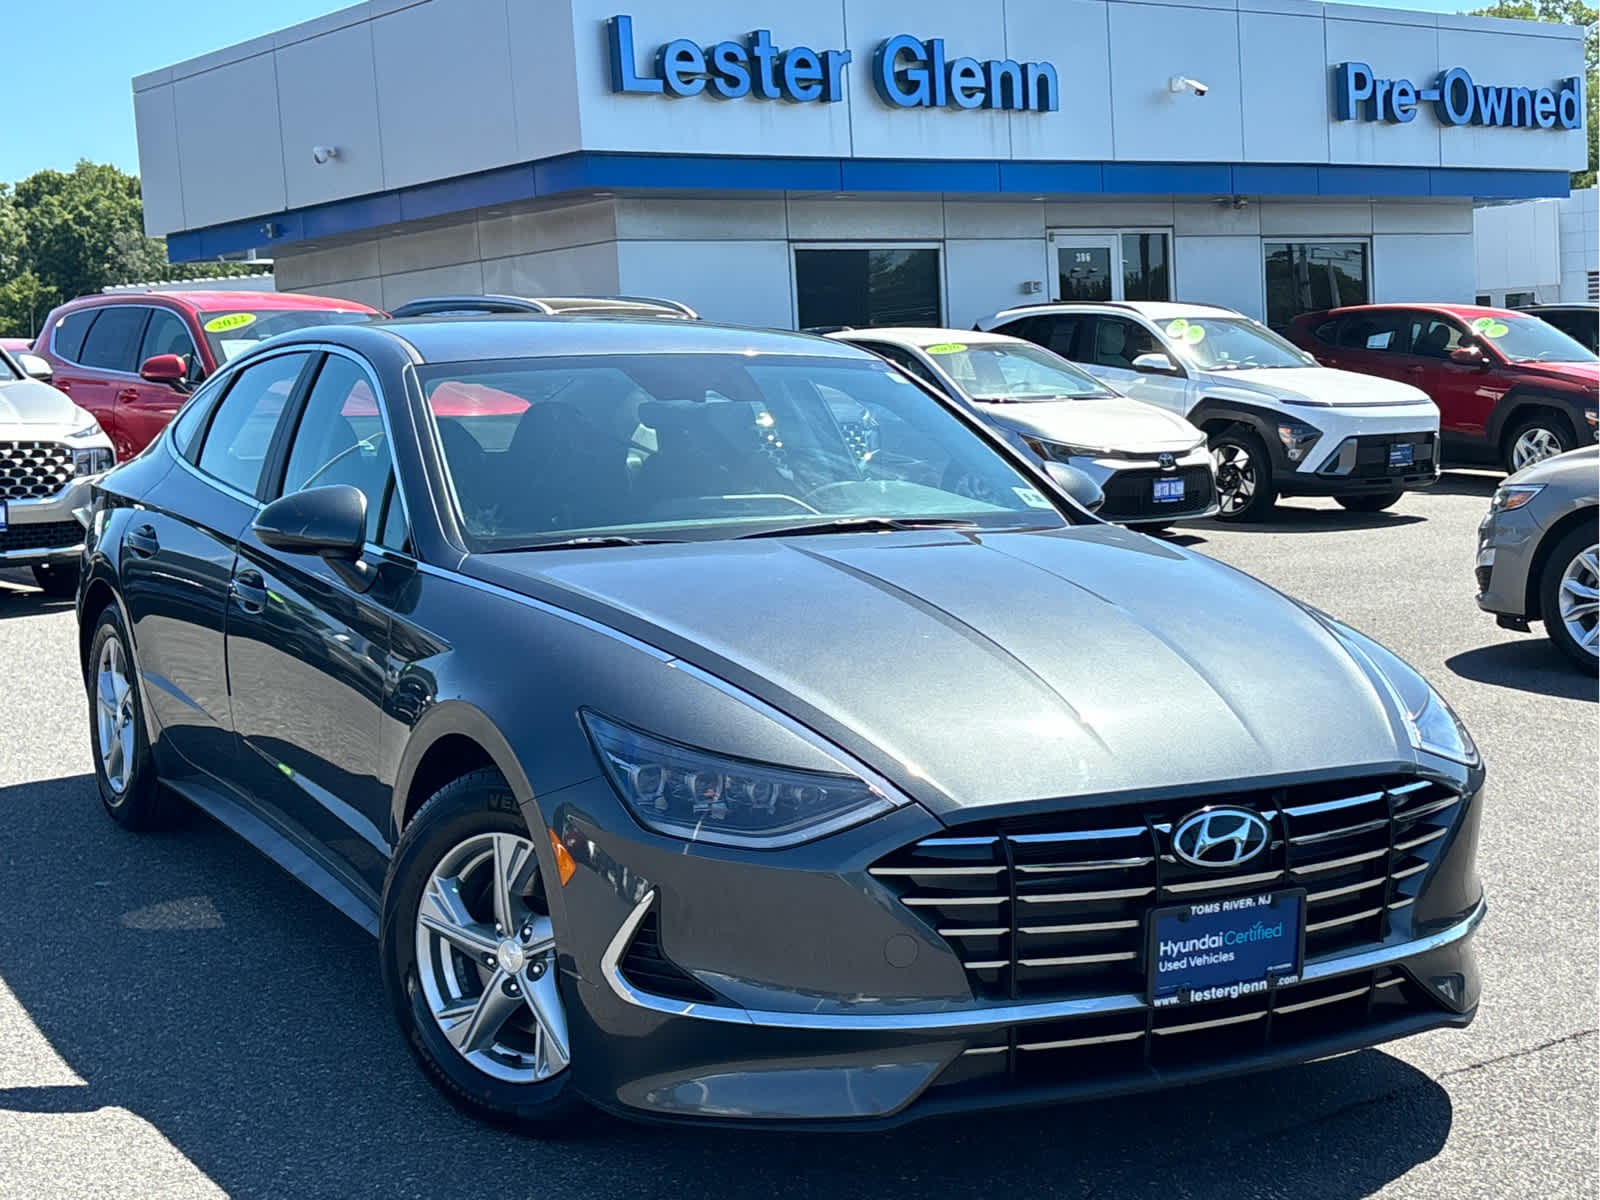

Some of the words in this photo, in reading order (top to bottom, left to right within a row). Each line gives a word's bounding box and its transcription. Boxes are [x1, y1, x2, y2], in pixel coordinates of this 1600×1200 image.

[607, 14, 852, 103] Lester
[873, 34, 1060, 113] Glenn
[1336, 61, 1582, 130] Pre-Owned
[215, 315, 246, 328] 2022
[1190, 903, 1220, 916] TOMS
[1258, 894, 1272, 905] NJ
[1159, 932, 1223, 957] Hyundai
[1224, 921, 1282, 945] Certified
[1159, 956, 1188, 973] Used
[1189, 951, 1235, 968] Vehicles
[1190, 980, 1268, 1002] lesterglenn
